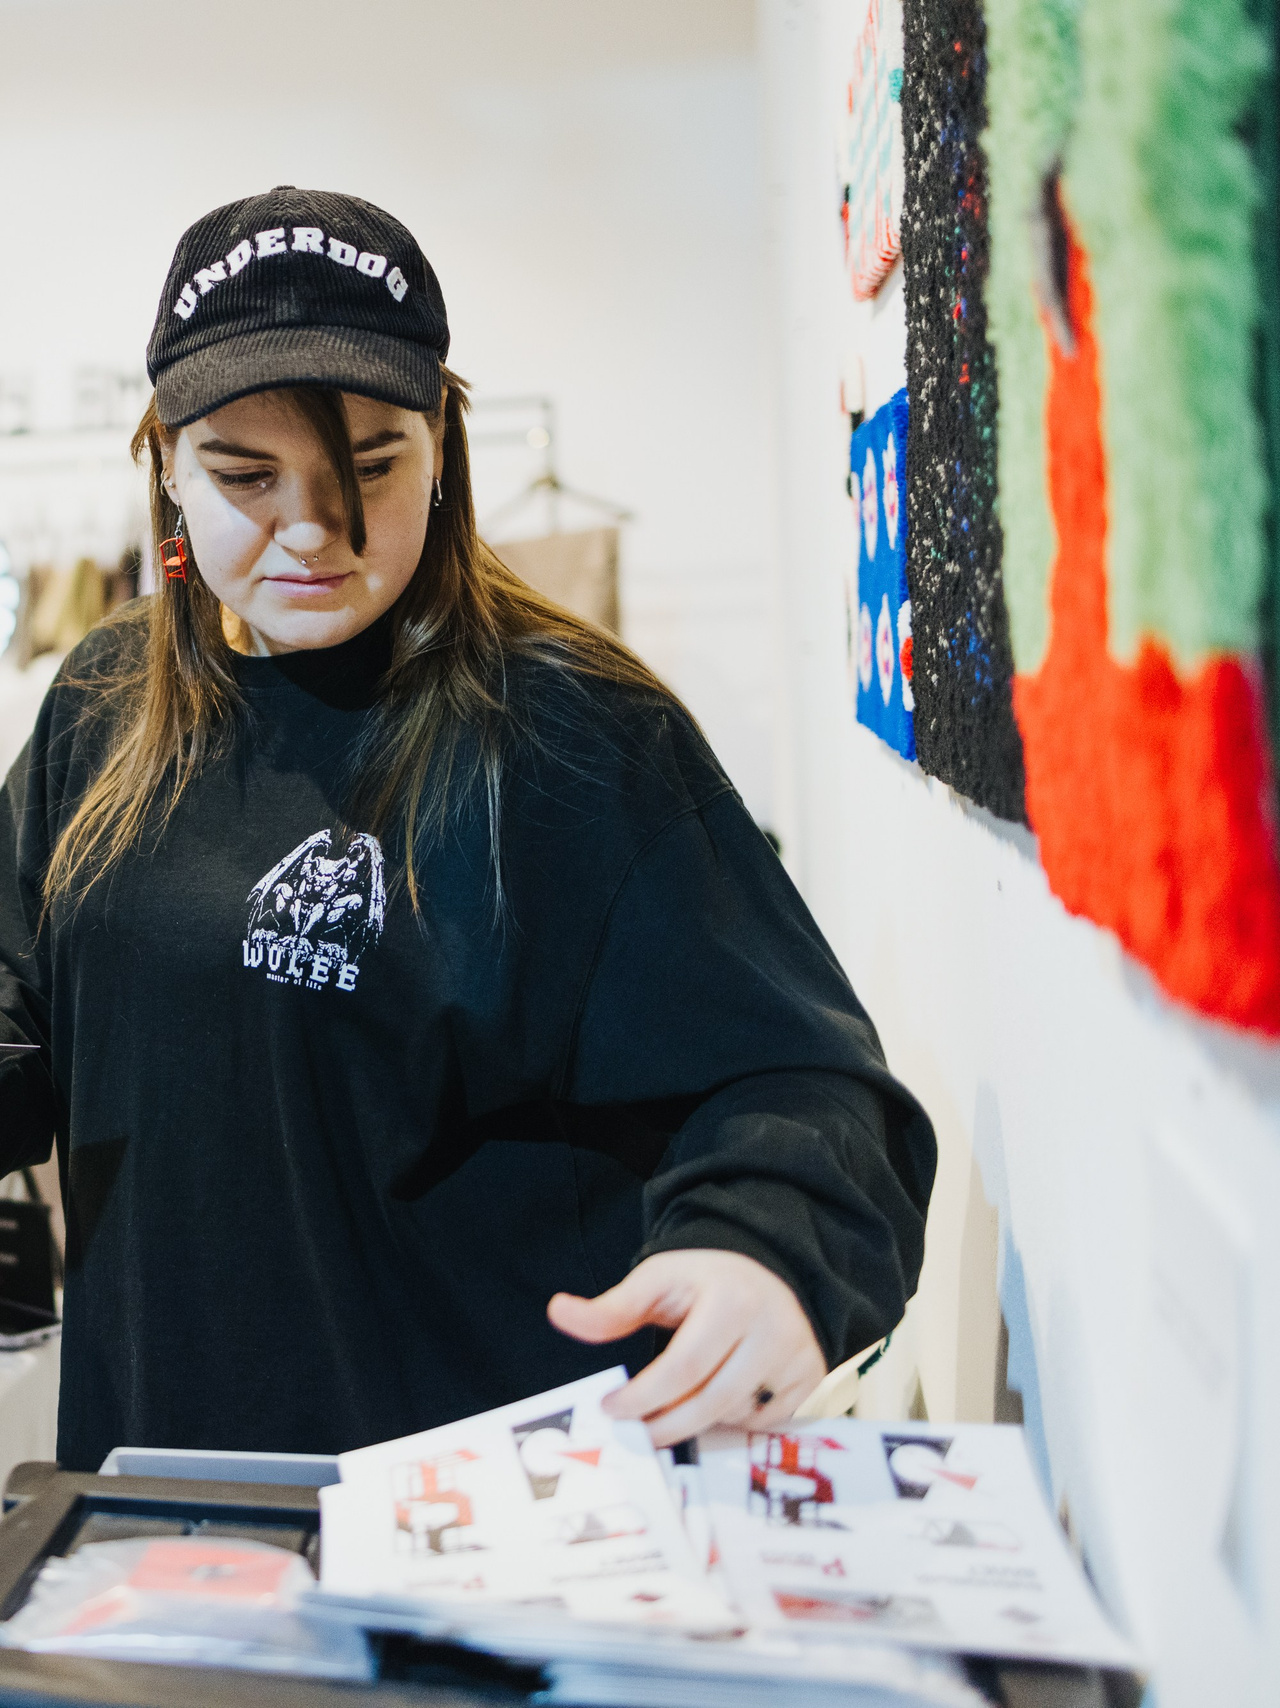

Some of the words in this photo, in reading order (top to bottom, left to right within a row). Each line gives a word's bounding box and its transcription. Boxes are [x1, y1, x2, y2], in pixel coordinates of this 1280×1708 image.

[173, 226, 409, 321] UNDERDOG
[266, 972, 290, 984] master
[293, 978, 302, 986] of
[305, 979, 322, 991] life
